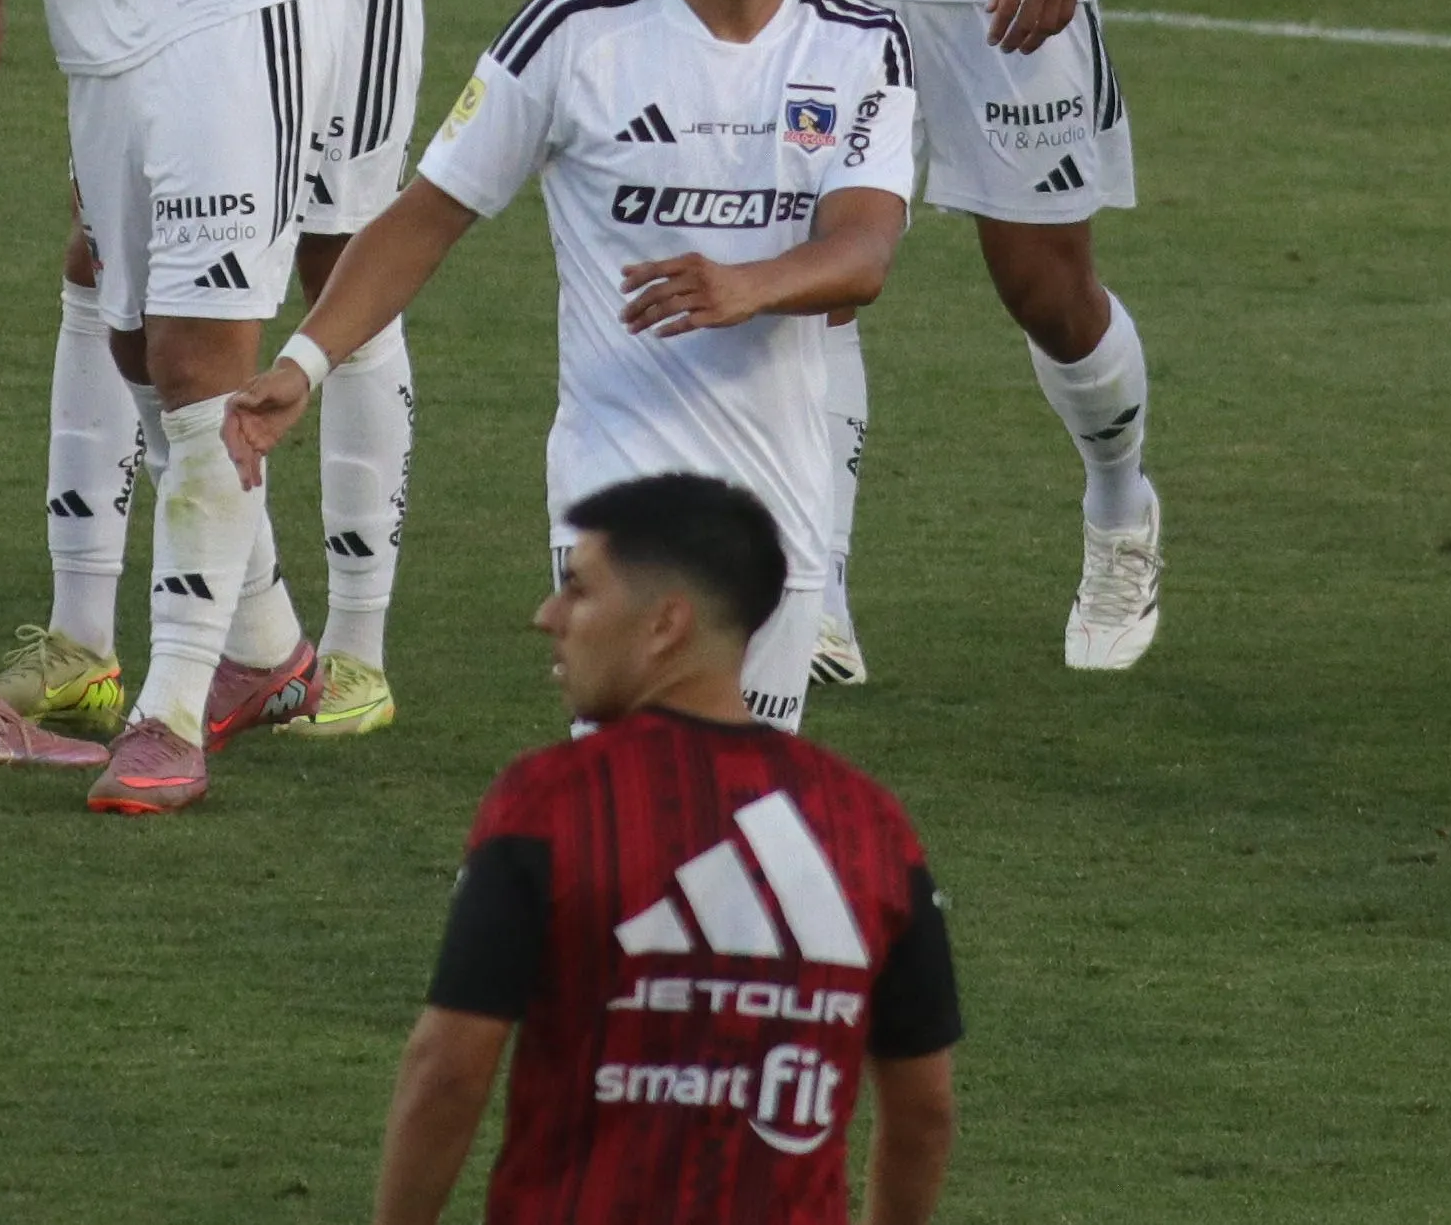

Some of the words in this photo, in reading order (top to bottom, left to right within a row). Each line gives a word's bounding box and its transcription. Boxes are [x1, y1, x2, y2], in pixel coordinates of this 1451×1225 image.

[985, 94, 1084, 126] PHILIPS
[680, 121, 777, 136] JETOUR
[986, 130, 1008, 149] TV
[1015, 131, 1029, 149] &
[1035, 126, 1086, 149] Audio
[156, 193, 256, 221] PHILIPS
[660, 188, 820, 229] JUGABE
[177, 226, 191, 245] &
[196, 221, 256, 242] Audio
[606, 975, 866, 1029] JETOUR
[594, 1062, 749, 1109] smart
